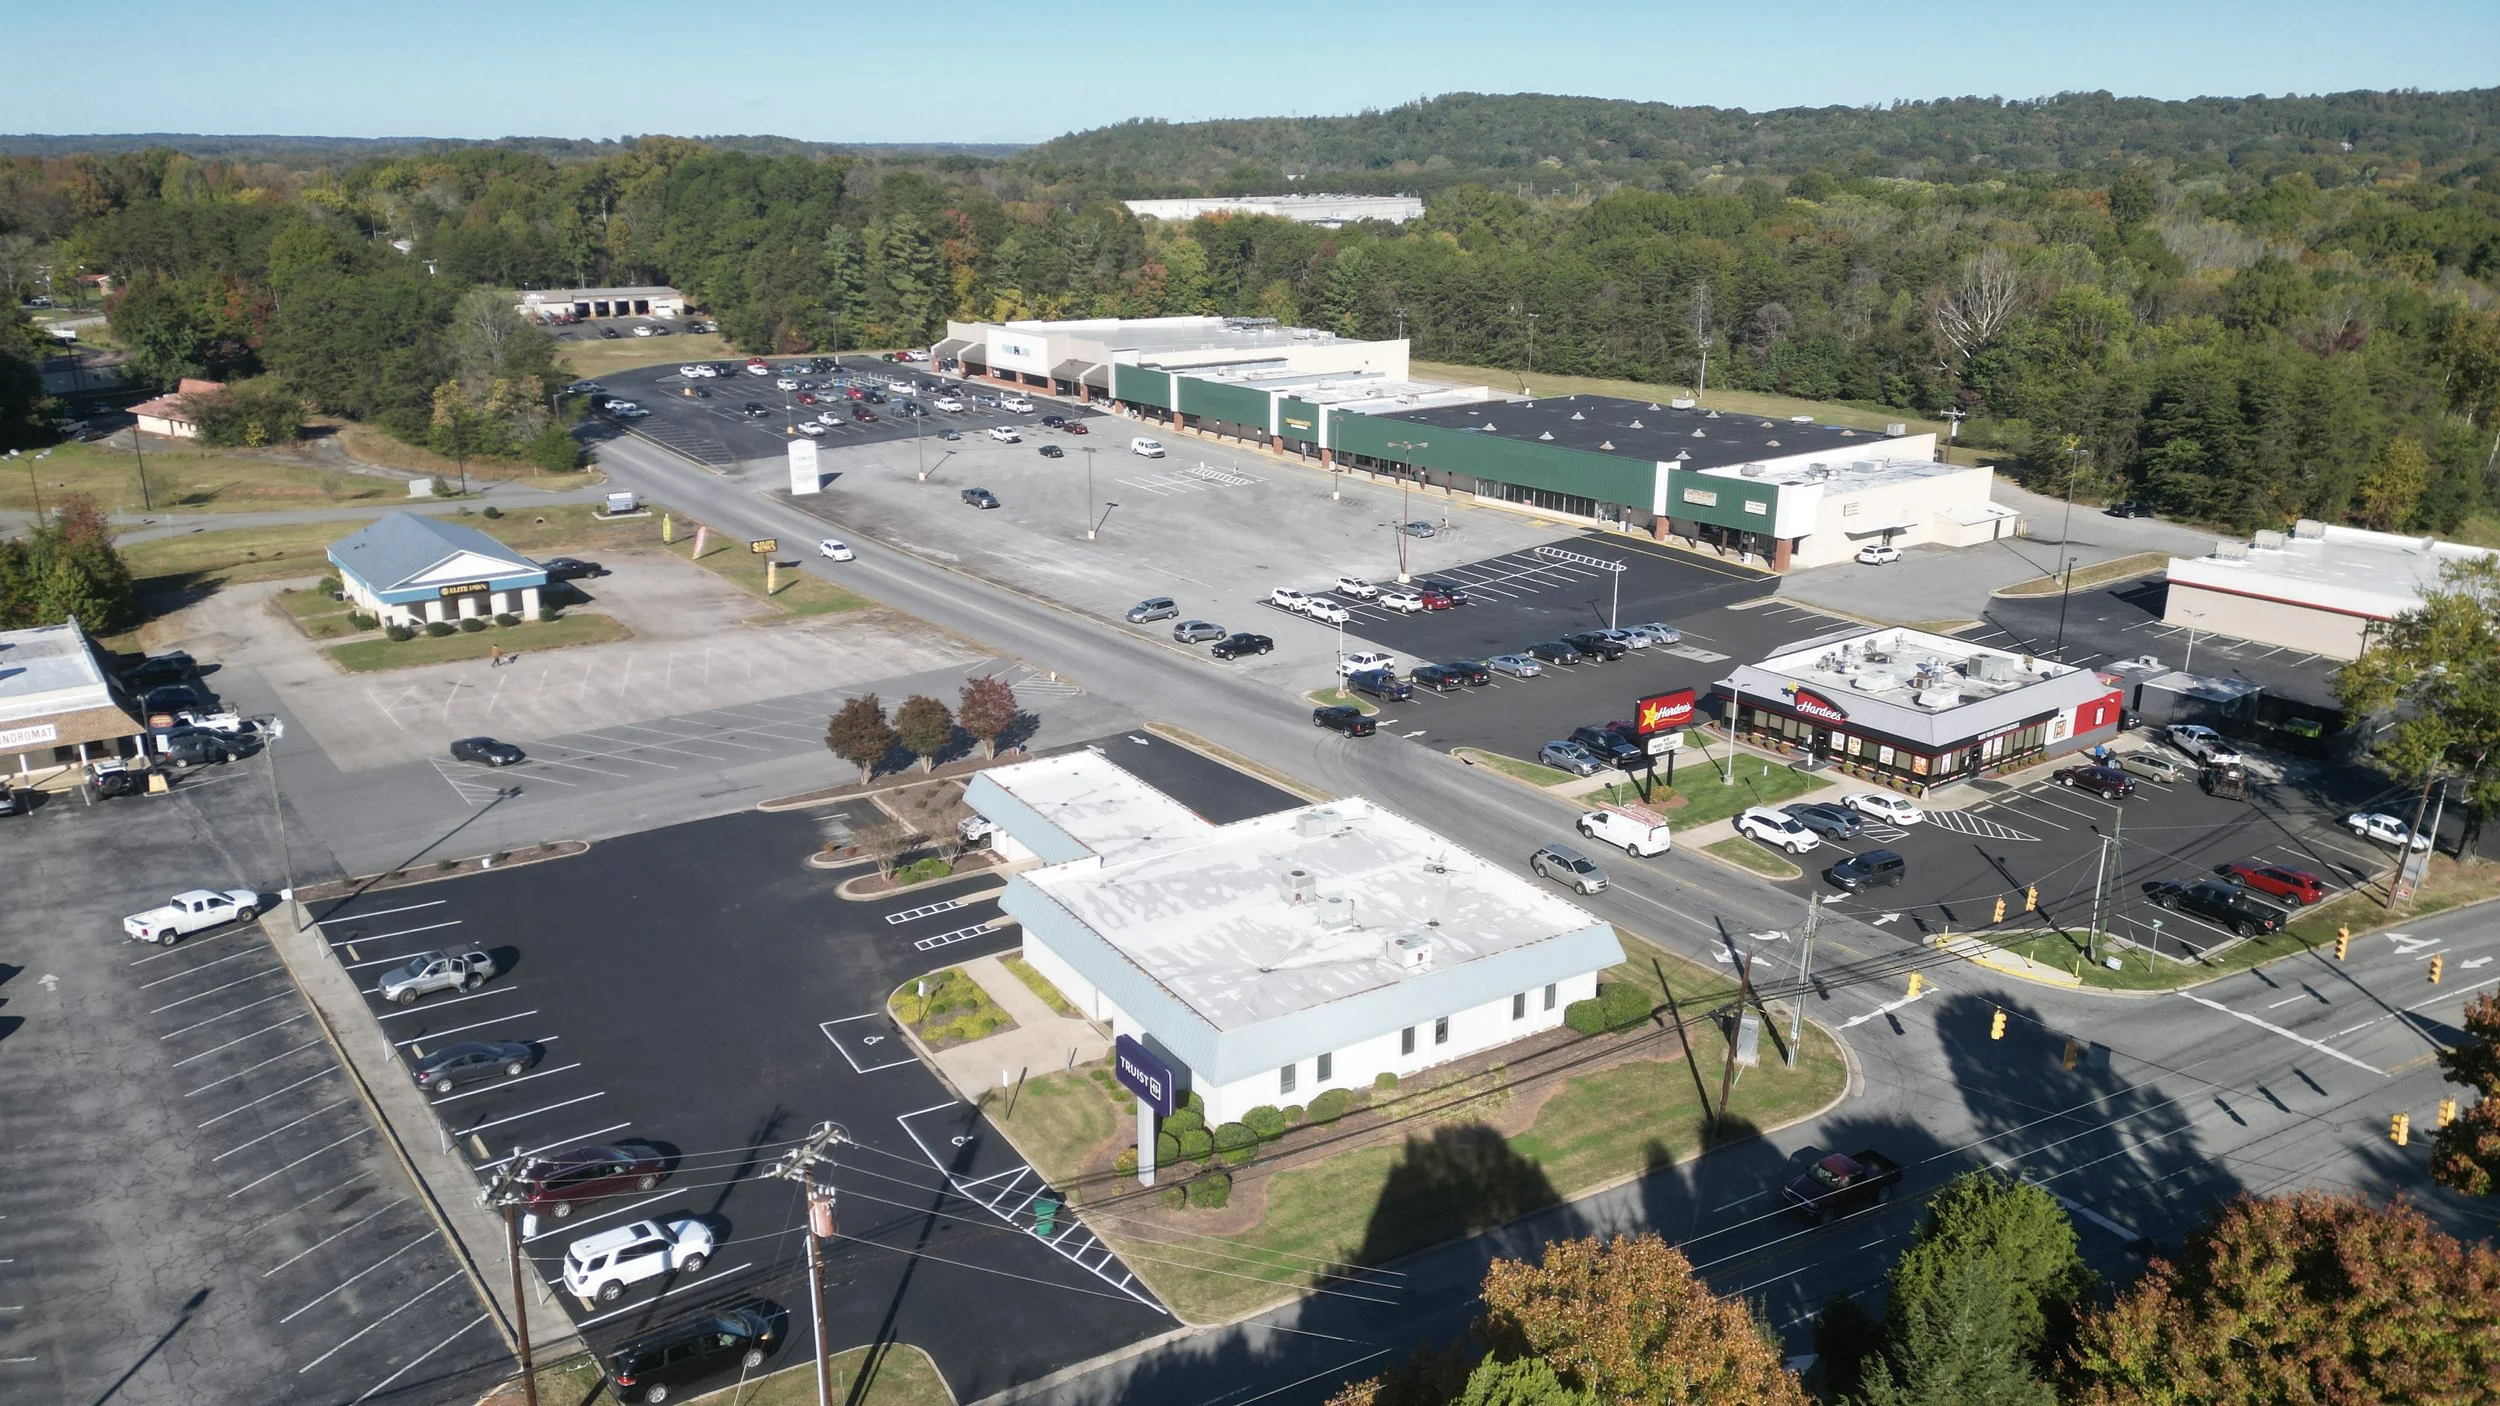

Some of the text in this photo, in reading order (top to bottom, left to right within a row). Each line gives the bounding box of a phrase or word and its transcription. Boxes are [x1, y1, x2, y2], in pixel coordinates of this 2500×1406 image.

[1654, 702, 1692, 721] Hardee's
[1796, 701, 1842, 721] Hardee's
[0, 727, 52, 745] NDROMAT
[1120, 1055, 1149, 1087] TRUIST
